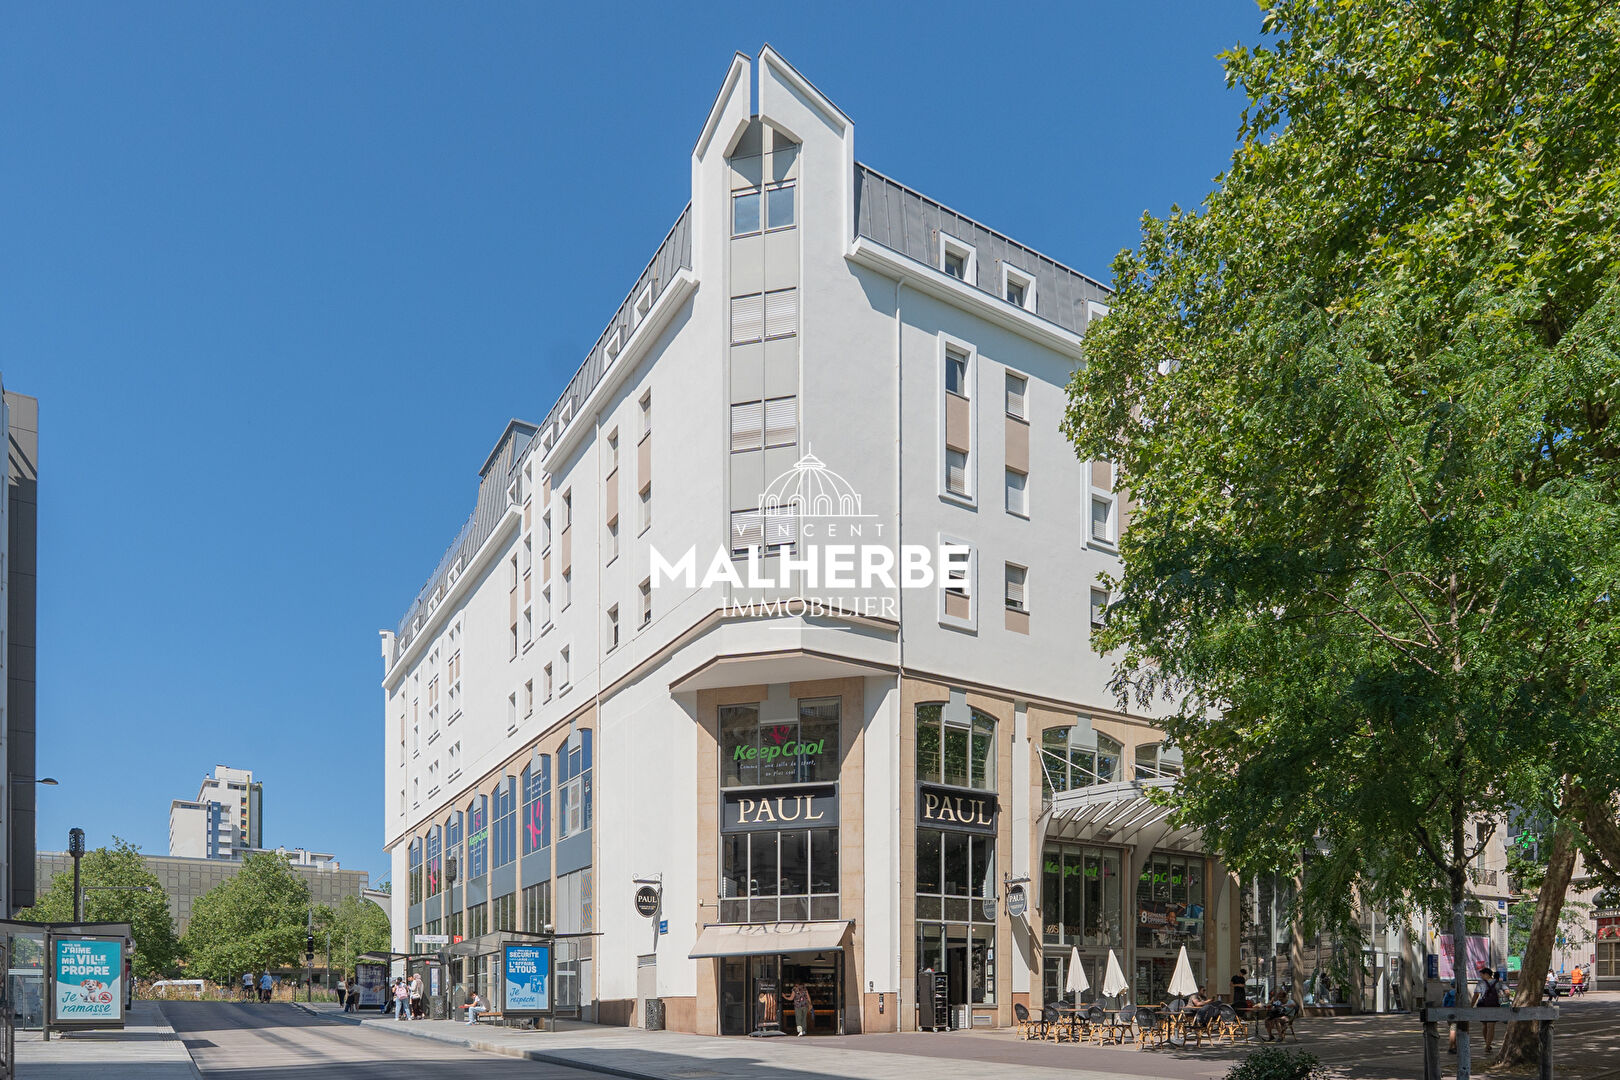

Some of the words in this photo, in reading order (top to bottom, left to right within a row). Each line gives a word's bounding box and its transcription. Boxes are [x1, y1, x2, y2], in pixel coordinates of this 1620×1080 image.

[737, 794, 824, 824] PAUL
[924, 793, 992, 826] PAUL
[637, 895, 657, 903] PAUL
[1009, 894, 1024, 903] PAUL
[1141, 911, 1148, 924] 8
[62, 957, 75, 965] MA
[77, 955, 106, 965] VILLE
[61, 965, 110, 976] PROPRE
[515, 966, 537, 974] TOUS
[62, 992, 77, 1003] Je
[62, 1004, 111, 1013] ramasse
